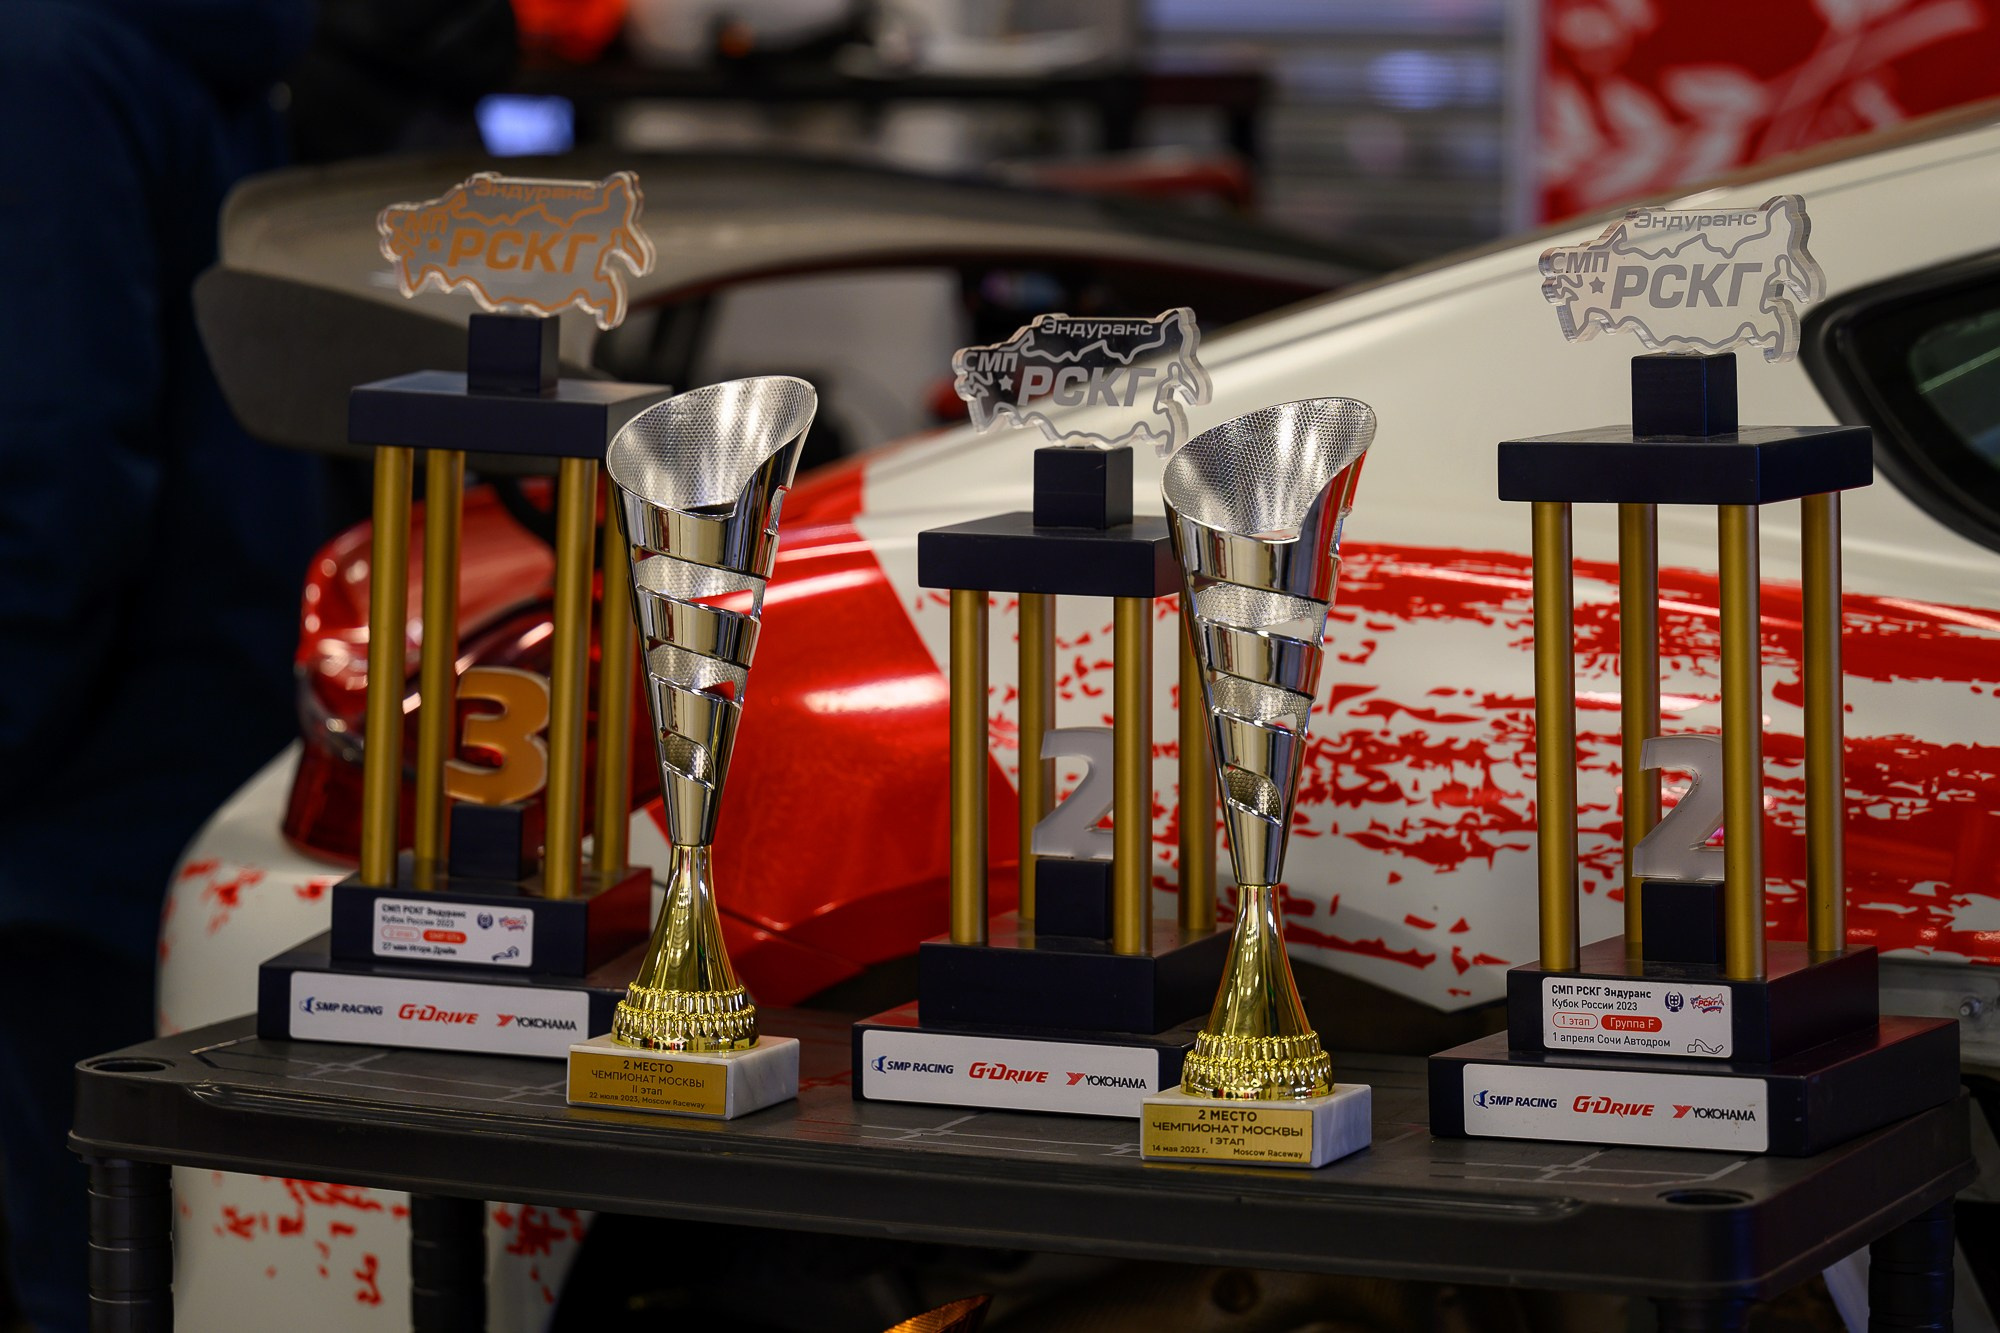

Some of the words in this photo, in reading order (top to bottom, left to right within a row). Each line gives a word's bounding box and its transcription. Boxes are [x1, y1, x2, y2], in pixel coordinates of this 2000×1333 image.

[1633, 212, 1757, 232] Эндуранс
[448, 228, 598, 274] РСКГ
[1550, 251, 1610, 274] СМП
[1610, 262, 1763, 310] РСКГ
[1041, 321, 1153, 338] Эндуранс
[964, 352, 1019, 373] СМП
[1018, 366, 1157, 407] РСКГ
[444, 666, 551, 806] 3
[1030, 727, 1114, 860] 2
[1632, 733, 1725, 882] 2
[1552, 985, 1573, 995] СМП
[1576, 986, 1602, 996] РСКГ
[1604, 987, 1651, 999] Эндуранс
[315, 1002, 340, 1012] SMP
[341, 1003, 383, 1015] RACING
[1552, 999, 1579, 1009] Кубок
[1581, 1000, 1614, 1010] России
[1616, 1001, 1638, 1011] 2023
[515, 1016, 577, 1031] YOKOHAMA
[1561, 1015, 1567, 1025] 1
[1569, 1018, 1590, 1027] этап
[1610, 1017, 1645, 1029] Группа
[1648, 1019, 1655, 1029] F
[1552, 1032, 1557, 1042] 1
[1560, 1034, 1594, 1045] апреля
[1597, 1035, 1621, 1045] Сочи
[1623, 1036, 1671, 1048] Автодром
[623, 1060, 630, 1070] 2
[633, 1061, 674, 1073] МЕСТО
[887, 1061, 911, 1071] SMP
[912, 1062, 954, 1075] RACING
[592, 1069, 656, 1084] ЧЕМПИОНАТ
[658, 1077, 705, 1088] МОСКВЫ
[1085, 1074, 1147, 1089] YOKOHAMA
[641, 1087, 663, 1096] этап
[599, 1093, 619, 1101] июля
[642, 1096, 671, 1105] Moscow
[673, 1099, 705, 1110] Raceway
[1489, 1095, 1514, 1106] SMP
[1515, 1097, 1558, 1109] RACING
[1198, 1110, 1206, 1120] 2
[1210, 1110, 1257, 1122] МЕСТО
[1692, 1106, 1756, 1122] YOKOHAMA
[1153, 1121, 1240, 1134] ЧЕМПИОНАТ
[1242, 1125, 1303, 1137] МОСКВЫ
[1216, 1138, 1245, 1146] ЭТАП
[1180, 1146, 1200, 1154] 2023
[1233, 1148, 1266, 1157] Moscow
[1268, 1150, 1303, 1159] Raceway
